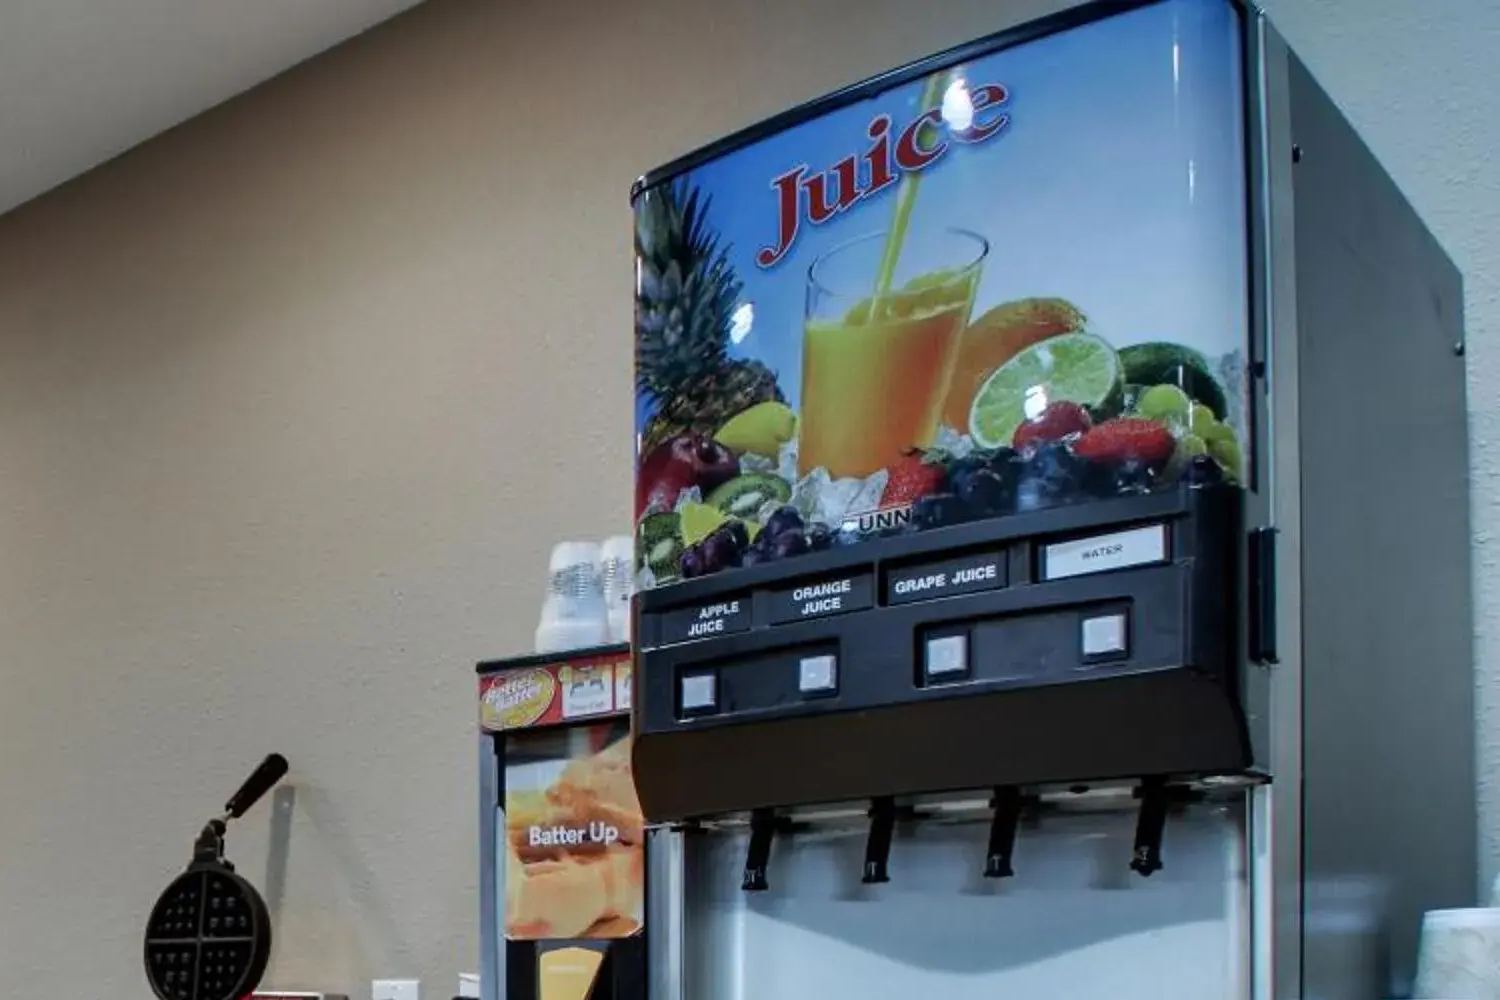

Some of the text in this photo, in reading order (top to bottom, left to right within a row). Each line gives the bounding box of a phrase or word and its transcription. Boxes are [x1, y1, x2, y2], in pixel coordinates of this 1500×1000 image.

[756, 82, 1010, 268] Juice
[842, 507, 911, 533] UNN
[793, 579, 851, 601] ORANGE
[894, 565, 997, 594] GRAPE JUICE
[699, 601, 740, 619] APPLE
[801, 597, 841, 615] JUICE
[688, 619, 724, 636] JUICE
[529, 821, 619, 846] Batter Up
